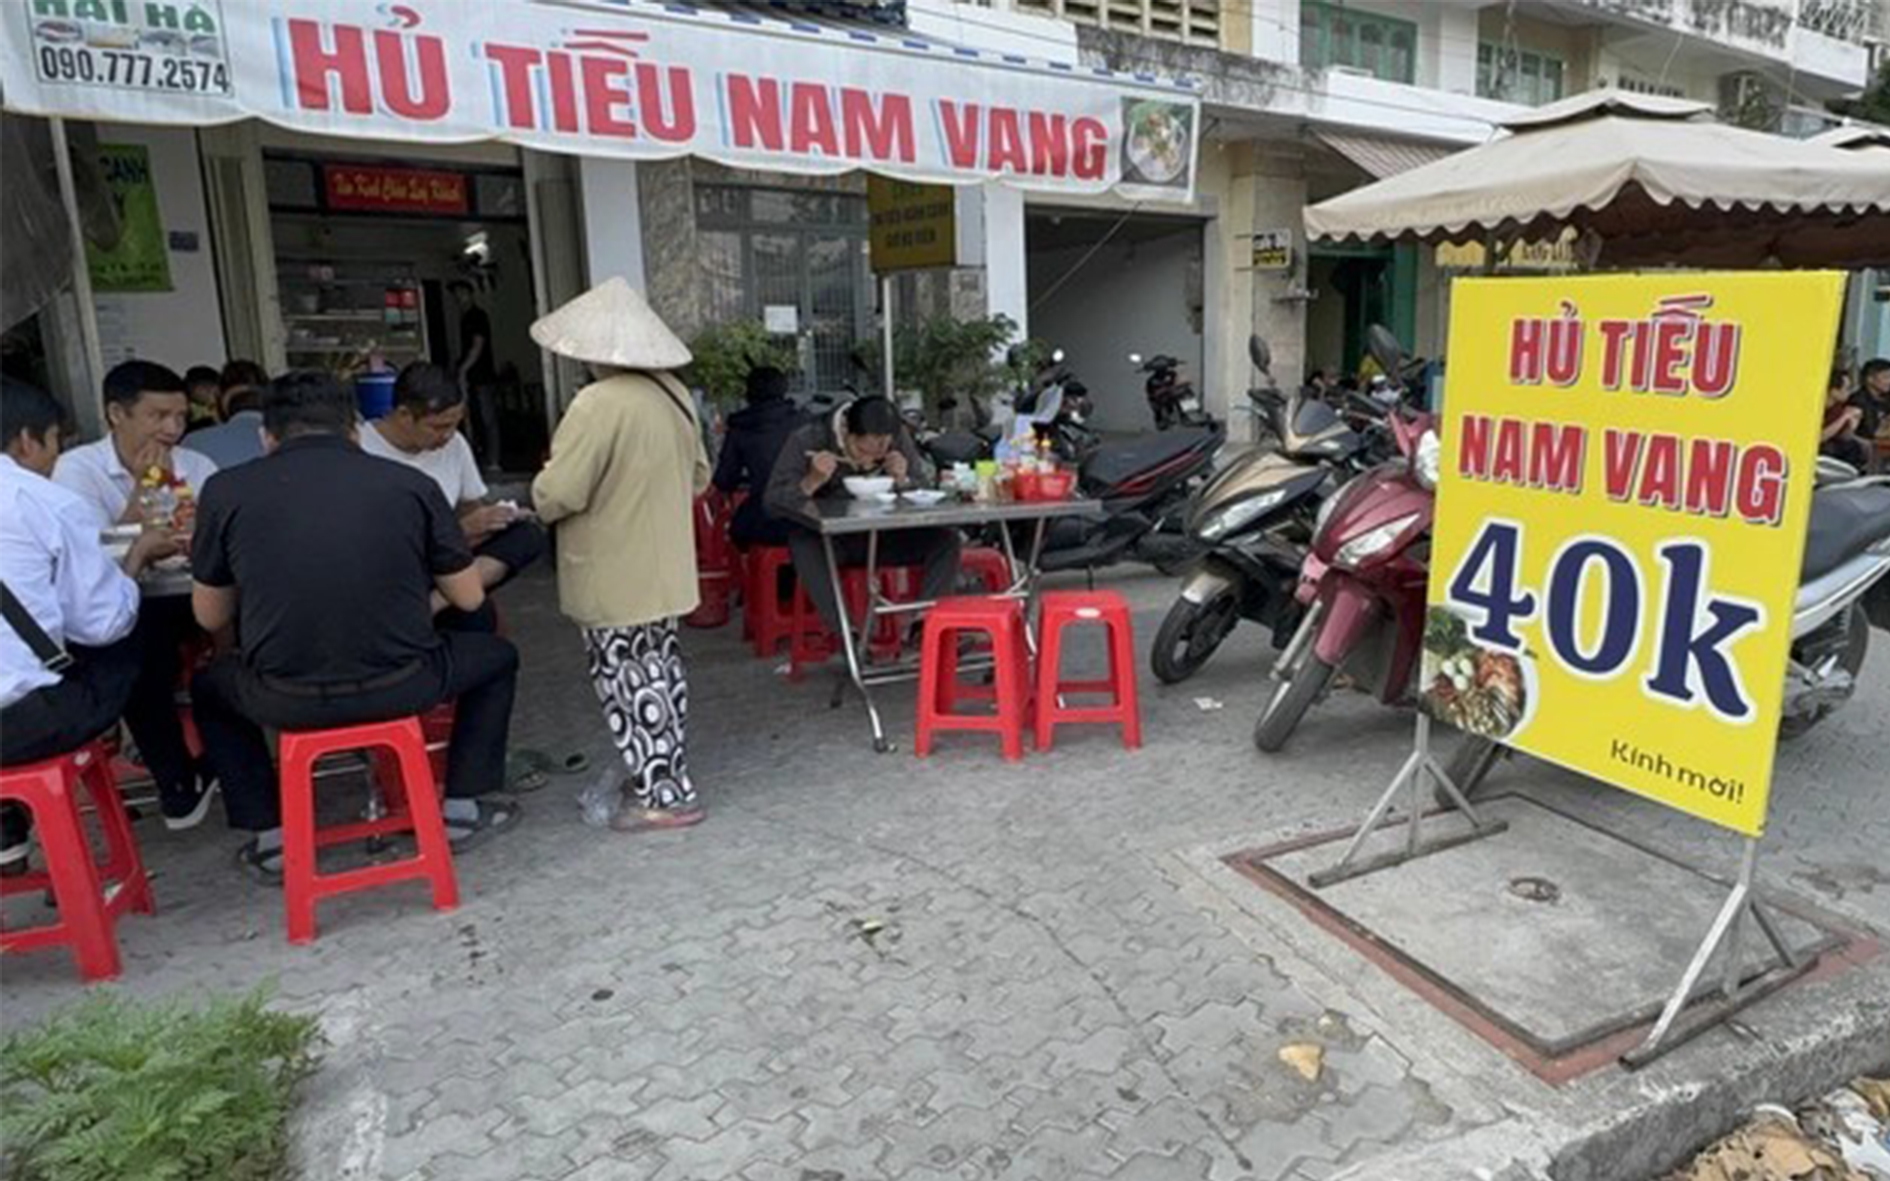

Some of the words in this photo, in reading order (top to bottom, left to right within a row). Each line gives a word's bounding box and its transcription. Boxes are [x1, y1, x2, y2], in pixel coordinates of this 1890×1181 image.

[40, 45, 229, 93] 090.777.2574
[287, 4, 451, 121] HỦ
[483, 29, 697, 143] TIẾU
[726, 73, 916, 163] NAM
[938, 98, 1109, 181] VANG
[1509, 301, 1582, 383] HỦ
[1599, 294, 1737, 395] TIẾU
[1458, 414, 1585, 490] NAM
[1603, 429, 1784, 523] VANG
[1449, 521, 1760, 717] 40k
